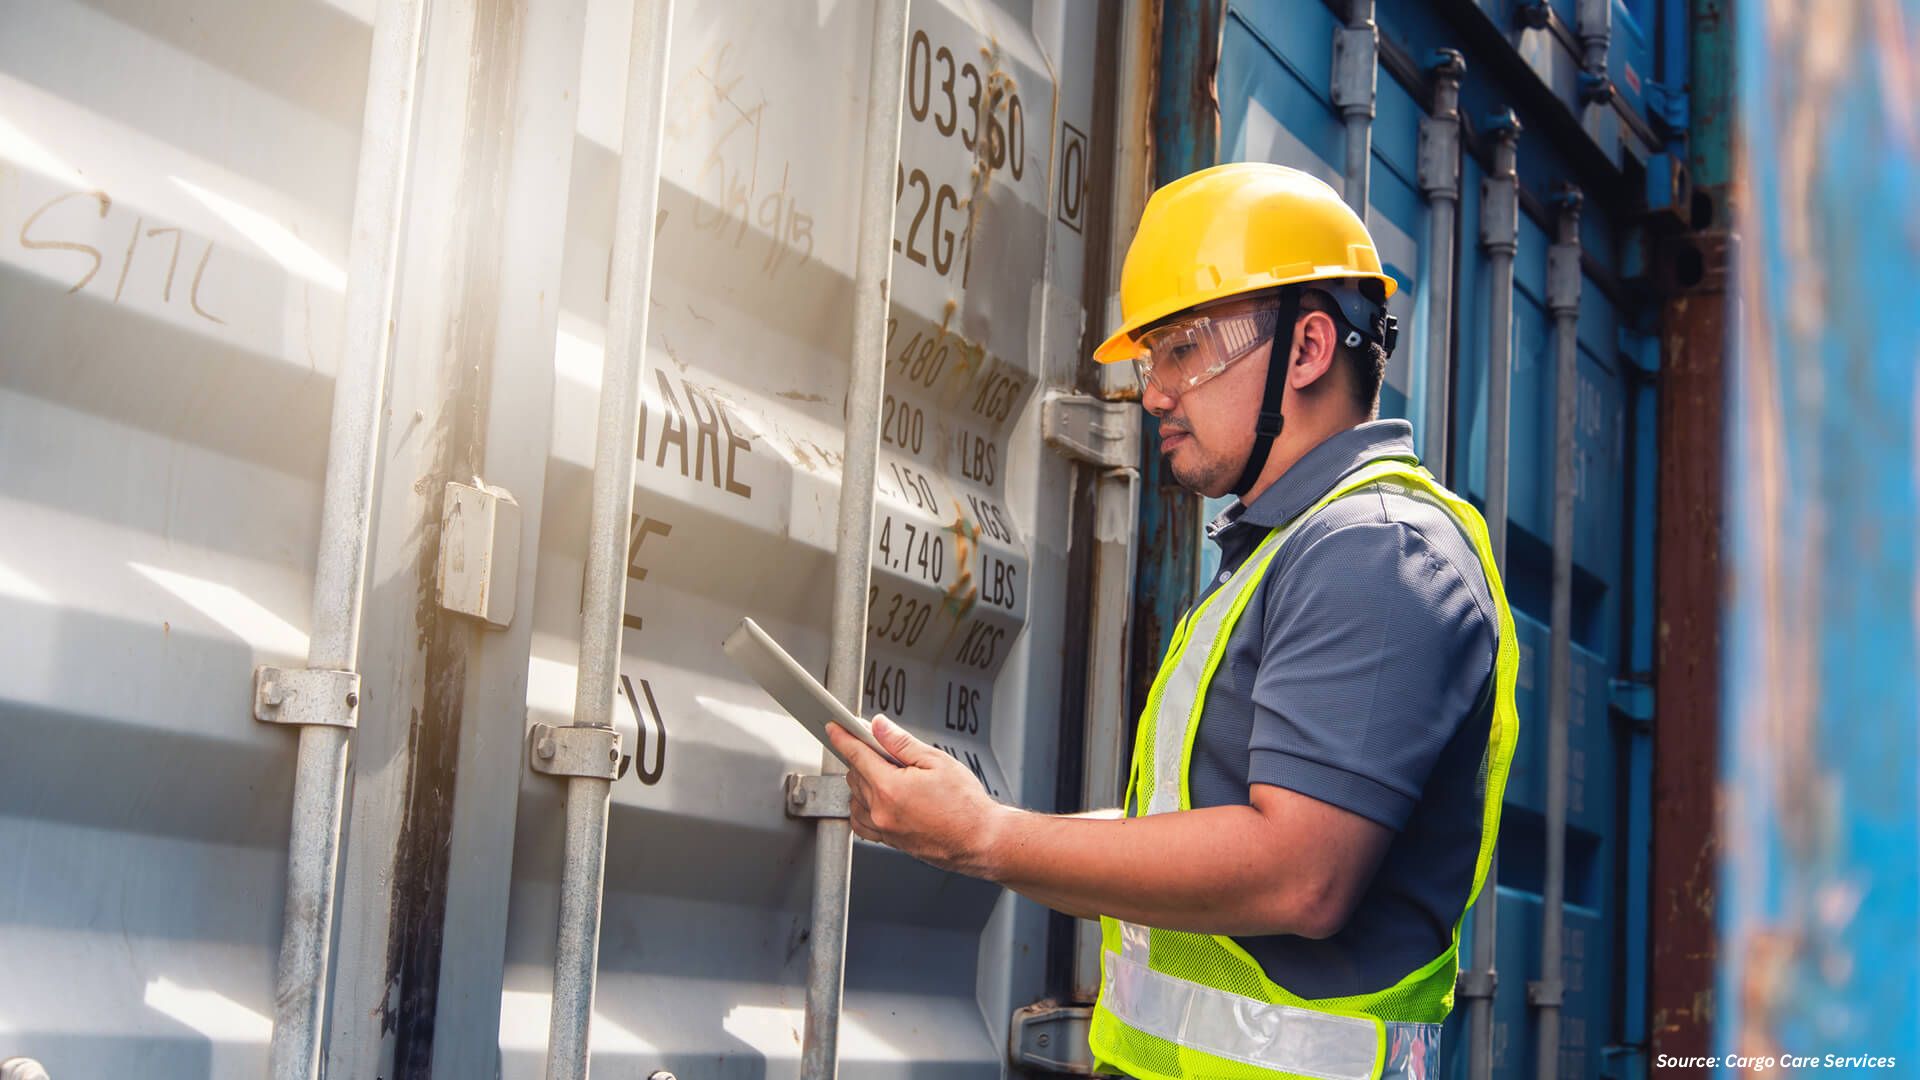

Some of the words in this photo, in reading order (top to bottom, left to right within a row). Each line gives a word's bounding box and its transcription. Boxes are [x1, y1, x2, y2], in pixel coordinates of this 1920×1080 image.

[971, 369, 1021, 424] KGS
[961, 431, 997, 487] LBS
[966, 493, 1012, 545] KGS
[981, 554, 1017, 610] LBS
[955, 618, 1005, 670] KGS
[864, 659, 906, 716] 460
[945, 681, 981, 736] LBS
